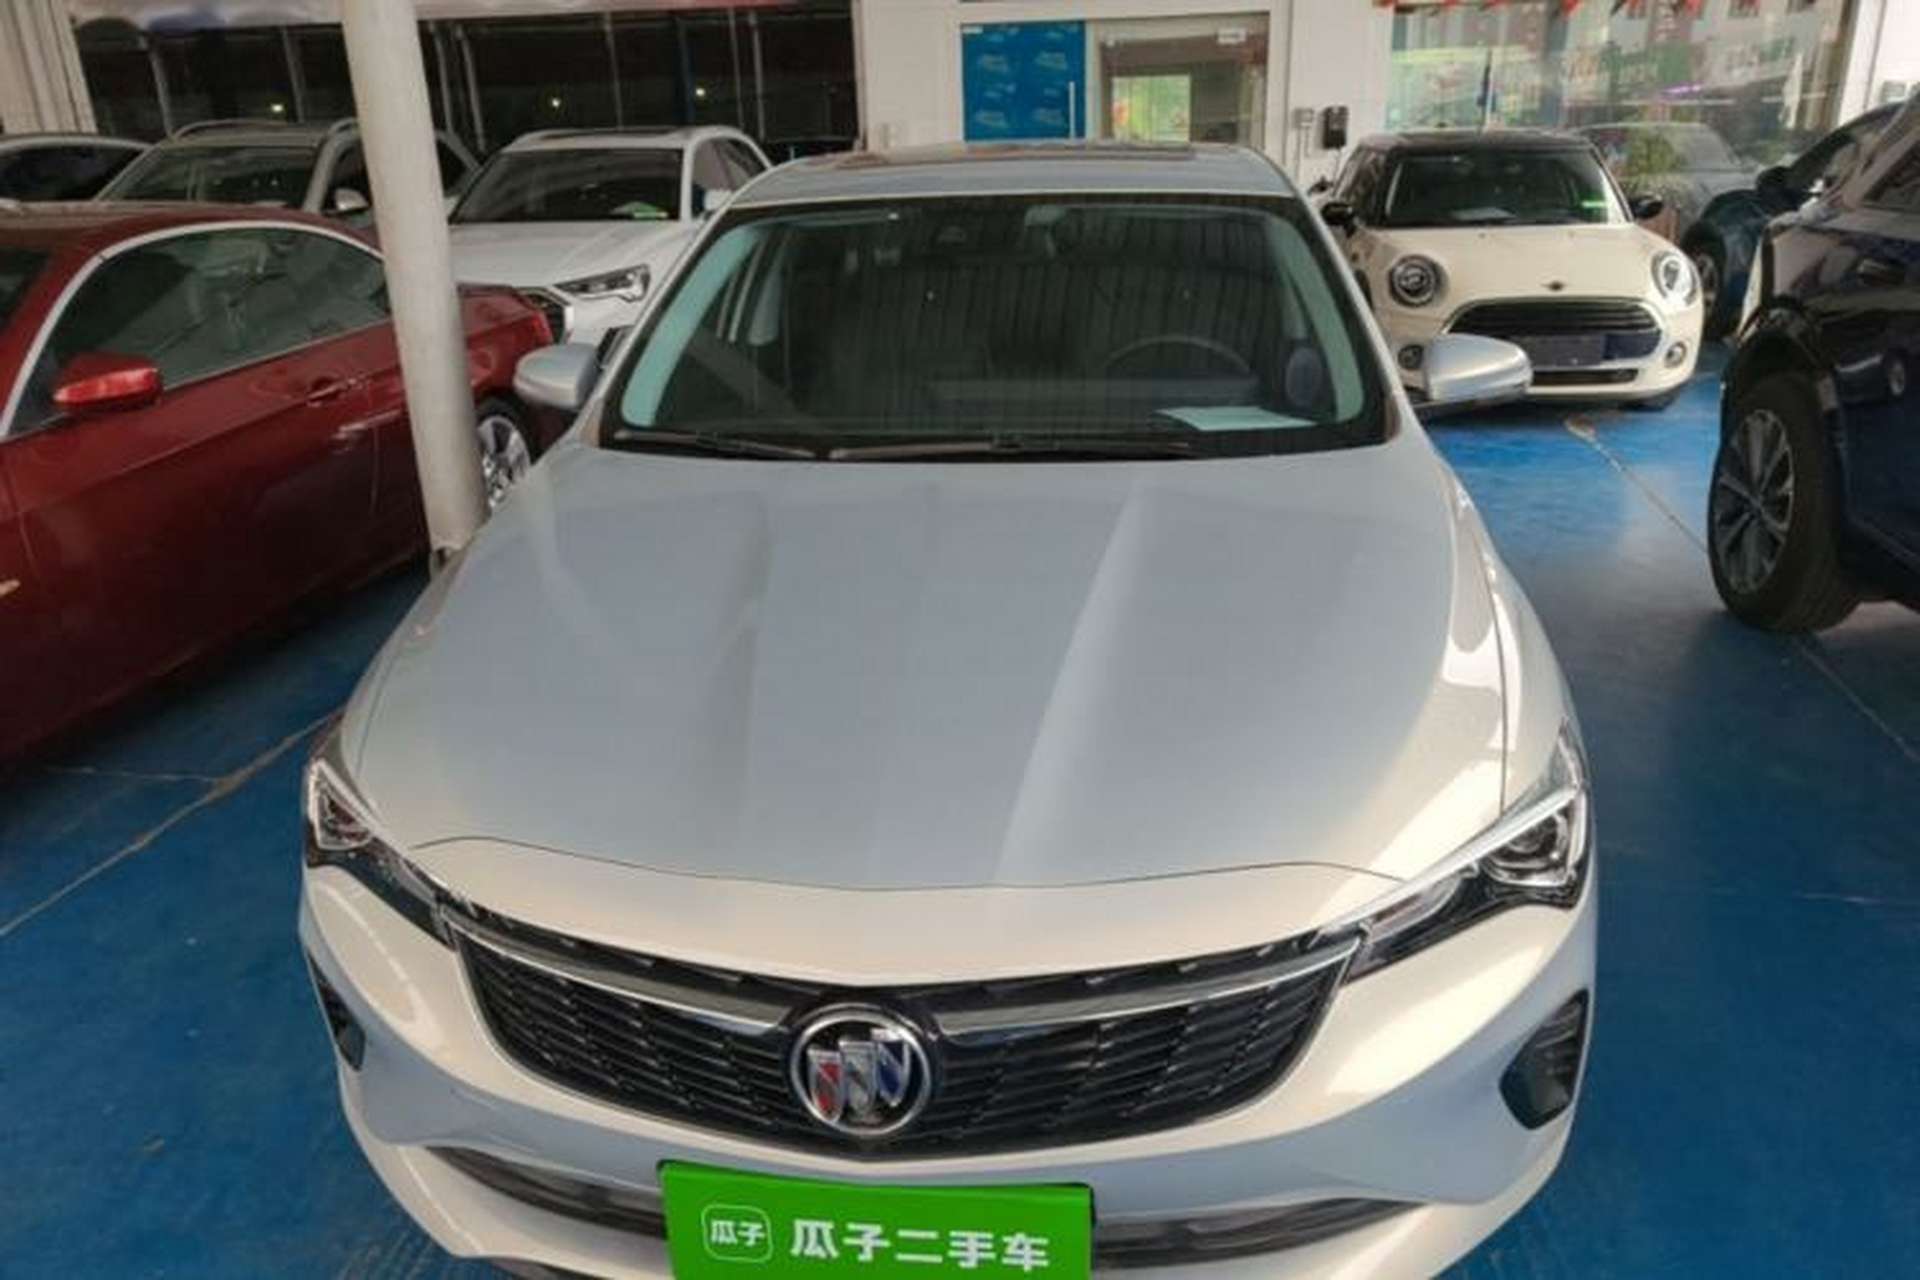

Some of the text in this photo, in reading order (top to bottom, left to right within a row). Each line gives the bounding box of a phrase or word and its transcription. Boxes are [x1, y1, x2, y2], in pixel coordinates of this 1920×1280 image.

[709, 1219, 766, 1247] 瓜子
[790, 1218, 1050, 1272] 瓜子二手车
